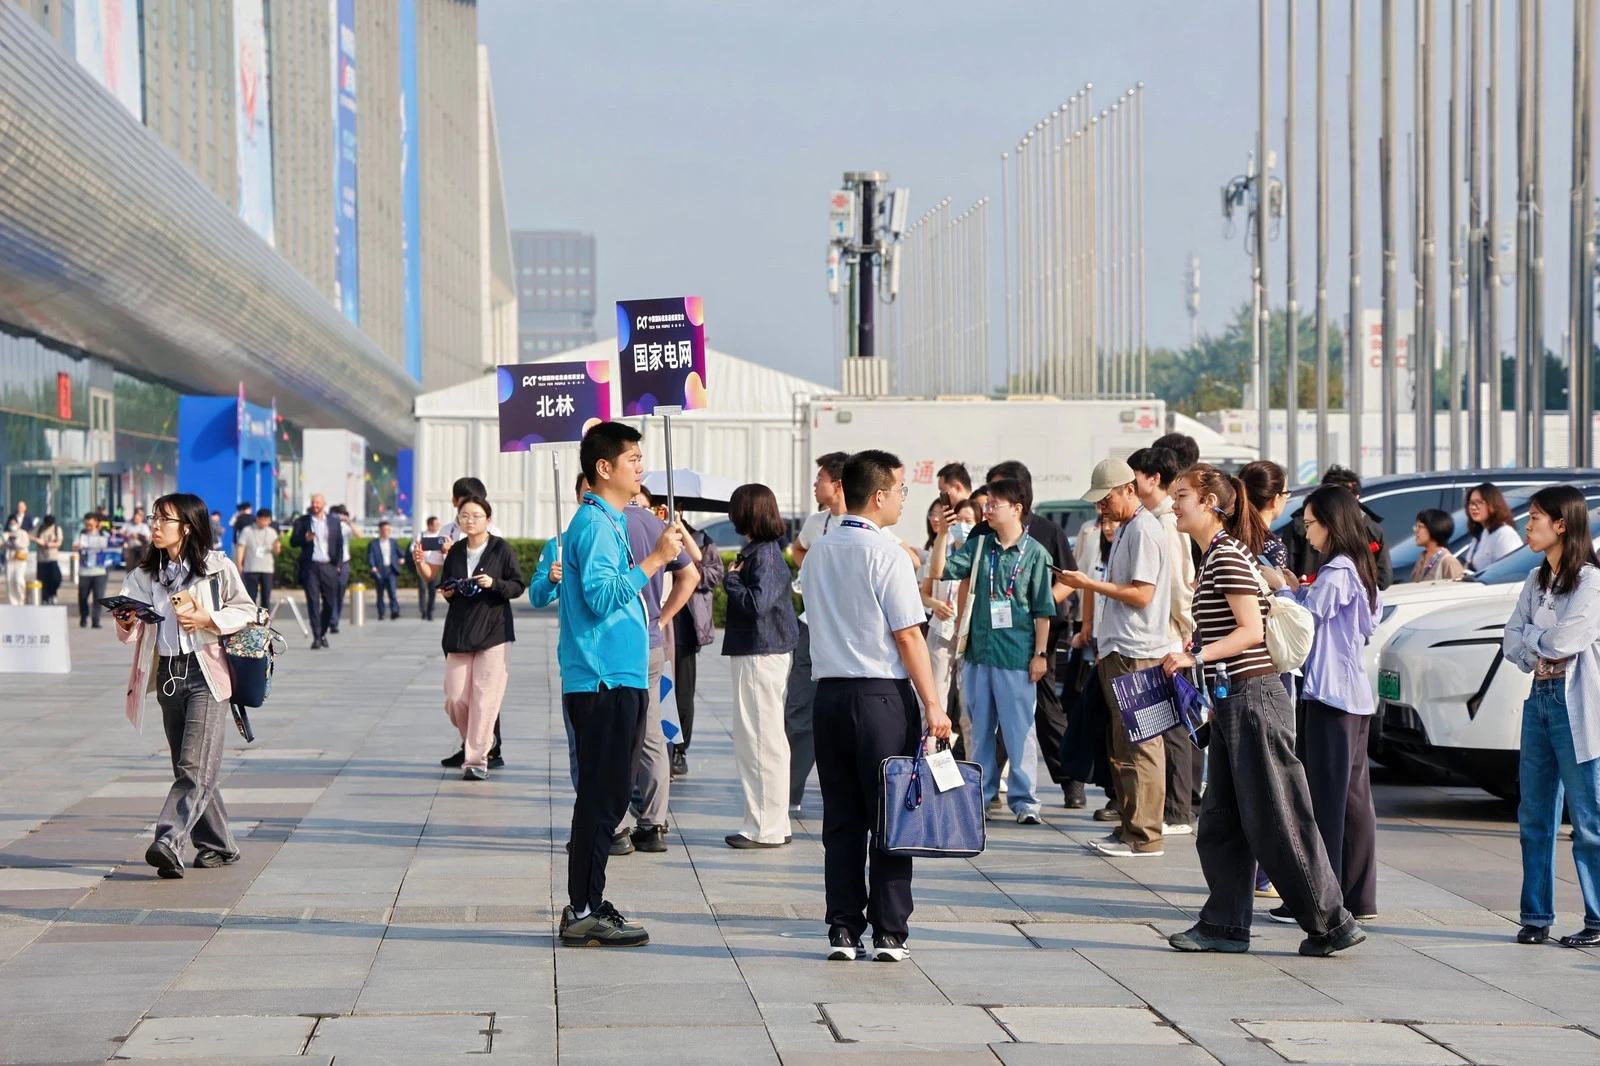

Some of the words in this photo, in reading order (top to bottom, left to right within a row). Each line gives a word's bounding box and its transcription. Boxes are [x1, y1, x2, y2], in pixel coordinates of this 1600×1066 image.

[633, 340, 693, 373] 国家电网
[536, 394, 575, 418] 北林
